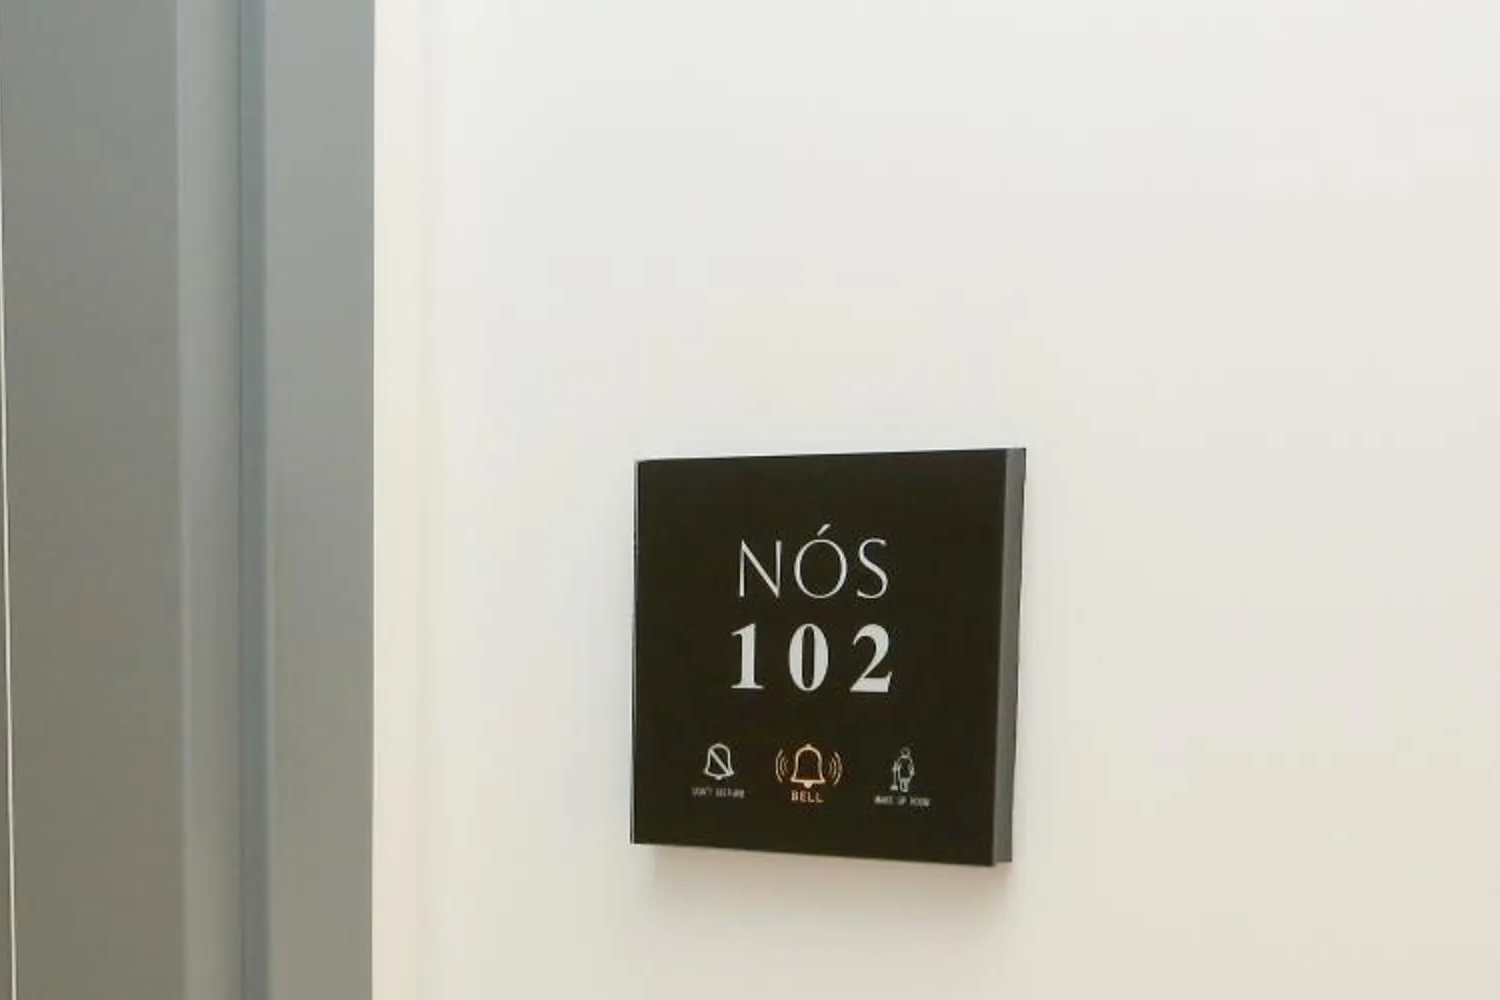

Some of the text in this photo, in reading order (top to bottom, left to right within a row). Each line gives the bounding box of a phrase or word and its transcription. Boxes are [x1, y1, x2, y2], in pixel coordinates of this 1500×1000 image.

[738, 523, 889, 600] NÓS
[730, 622, 893, 693] 102
[791, 790, 824, 804] BELL
